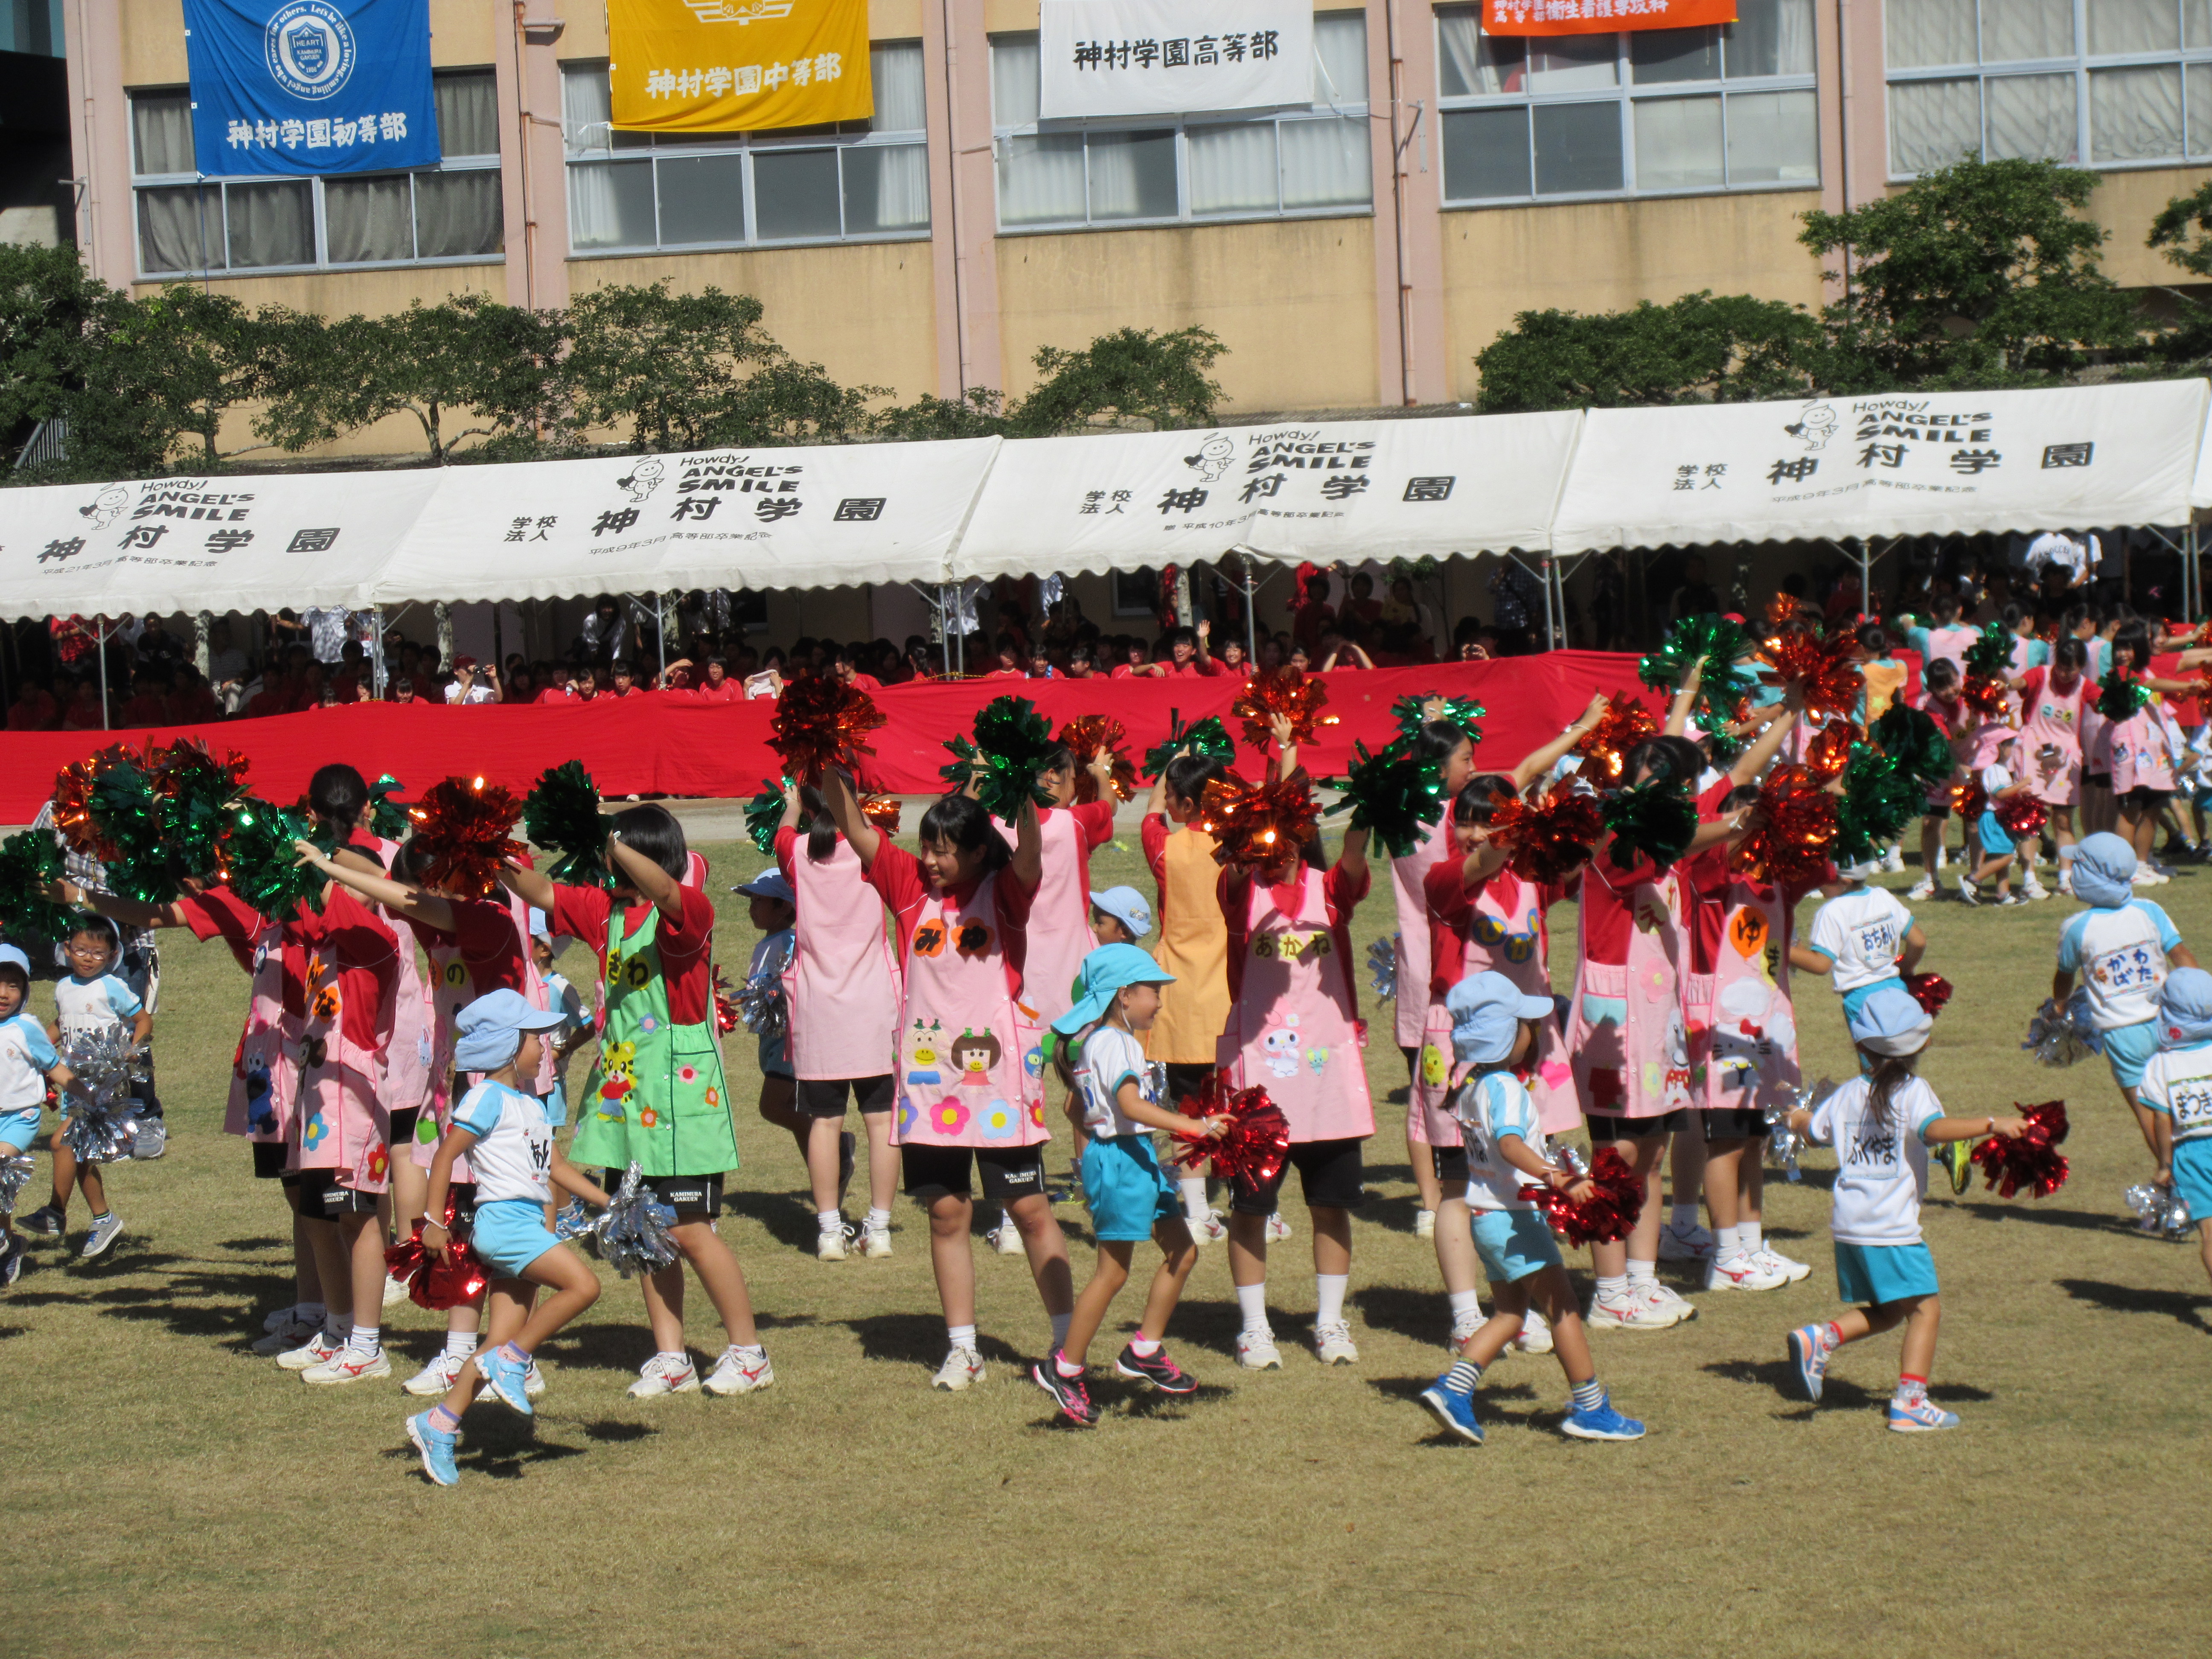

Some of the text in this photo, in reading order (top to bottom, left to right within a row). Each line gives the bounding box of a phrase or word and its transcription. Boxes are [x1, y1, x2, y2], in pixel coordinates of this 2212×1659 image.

[311, 4, 329, 16] Let's
[328, 12, 337, 23] be
[335, 21, 348, 40] like
[1072, 30, 1280, 71] 神村学園高等部
[645, 52, 842, 100] 神村学園中等部
[226, 112, 407, 150] 神村学園初等部
[1853, 400, 1930, 412] Howdy!
[1858, 412, 1992, 427] ANGEL'S
[1249, 431, 1320, 445] Howdy!
[1855, 425, 1991, 442] SMILE
[1252, 440, 1377, 457] ANGEL'S
[680, 454, 750, 466] Howdy!
[1247, 455, 1372, 474] SMILE
[1766, 441, 2094, 485] 神村学園
[682, 465, 803, 478] ANGEL'S
[1678, 464, 1728, 477] 学校
[140, 480, 208, 494] Howdy!
[676, 479, 800, 493] SMILE
[1673, 479, 1722, 491] 法人
[138, 491, 255, 505] ANGEL'S
[1085, 490, 1133, 503] 学校
[1157, 473, 1456, 515] 神村学園
[129, 505, 250, 521] SMILE
[1079, 503, 1125, 515] 法人
[512, 515, 558, 529] 学校
[591, 497, 887, 538] 神村学園
[504, 529, 549, 542] 法人
[37, 524, 341, 564] 神村学園
[1256, 933, 1331, 958] あかね
[1009, 1176, 1034, 1184] GAKUEN
